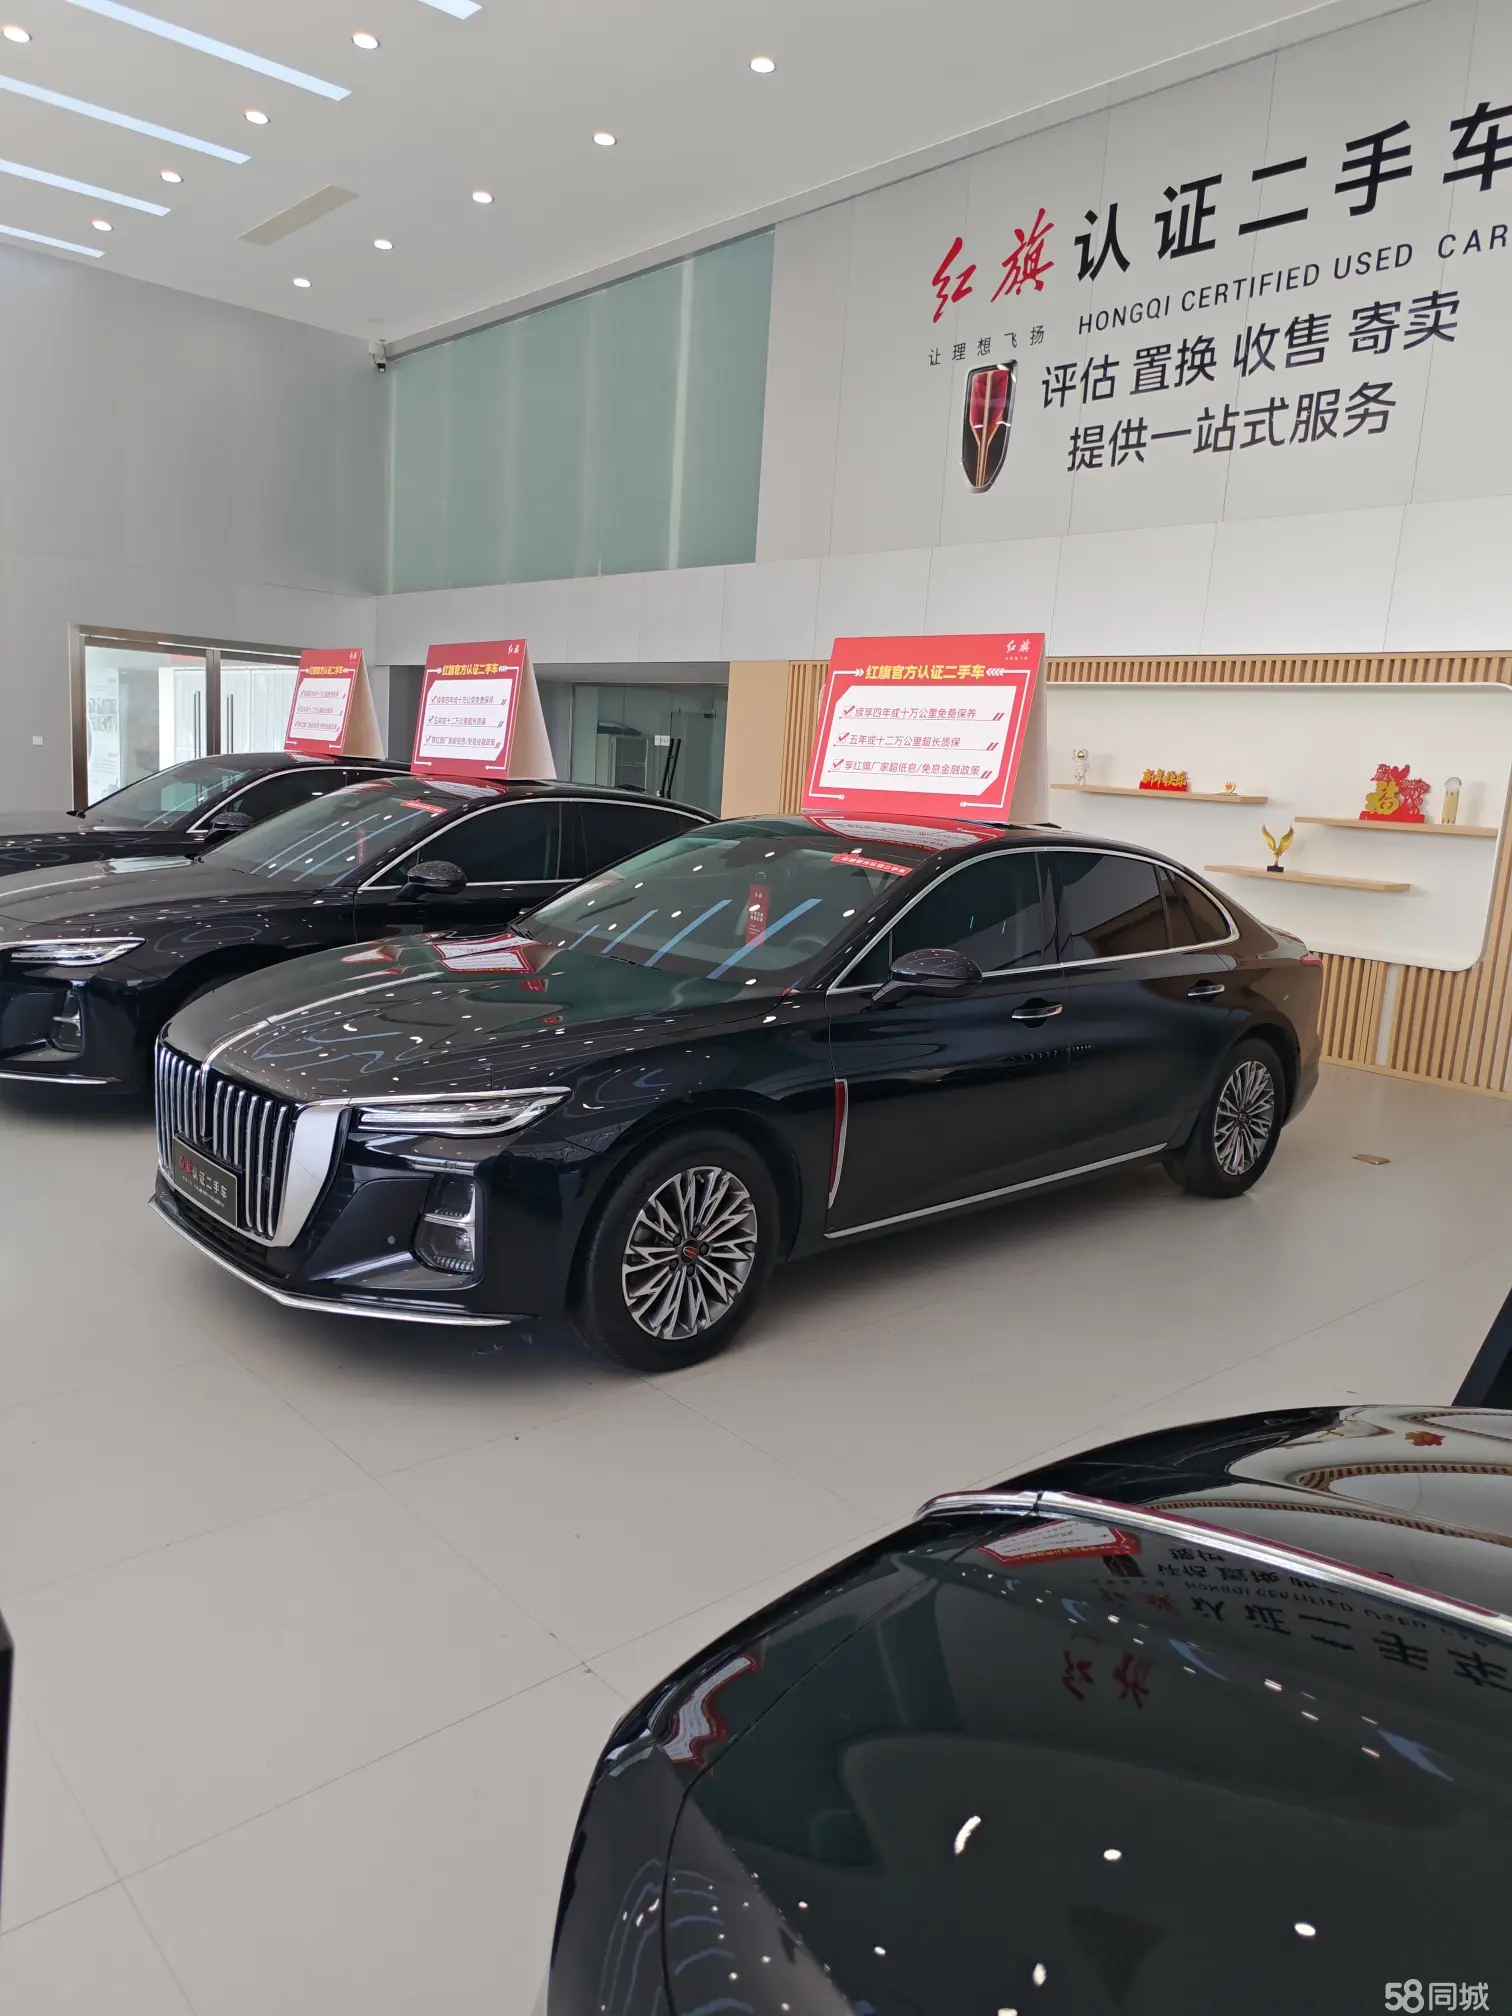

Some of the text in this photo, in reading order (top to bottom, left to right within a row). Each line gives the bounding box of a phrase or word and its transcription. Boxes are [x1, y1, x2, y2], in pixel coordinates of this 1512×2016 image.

[932, 102, 1512, 323] 红旗 认证二手车
[1078, 224, 1509, 334] HONGQI CERTIFIED USED CAR
[928, 325, 1045, 366] 让理想飞扬
[1041, 288, 1461, 409] 评估 置换 收售 寄卖
[1067, 381, 1397, 473] 提供一站式服务
[865, 664, 985, 680] 红旗官方认证二手车
[855, 708, 977, 720] 续享四年或十万公里免费保养
[849, 735, 961, 748] 五年或十二万公里超长质保
[844, 761, 981, 776] 享红旗厂家超低息/免息金融政策
